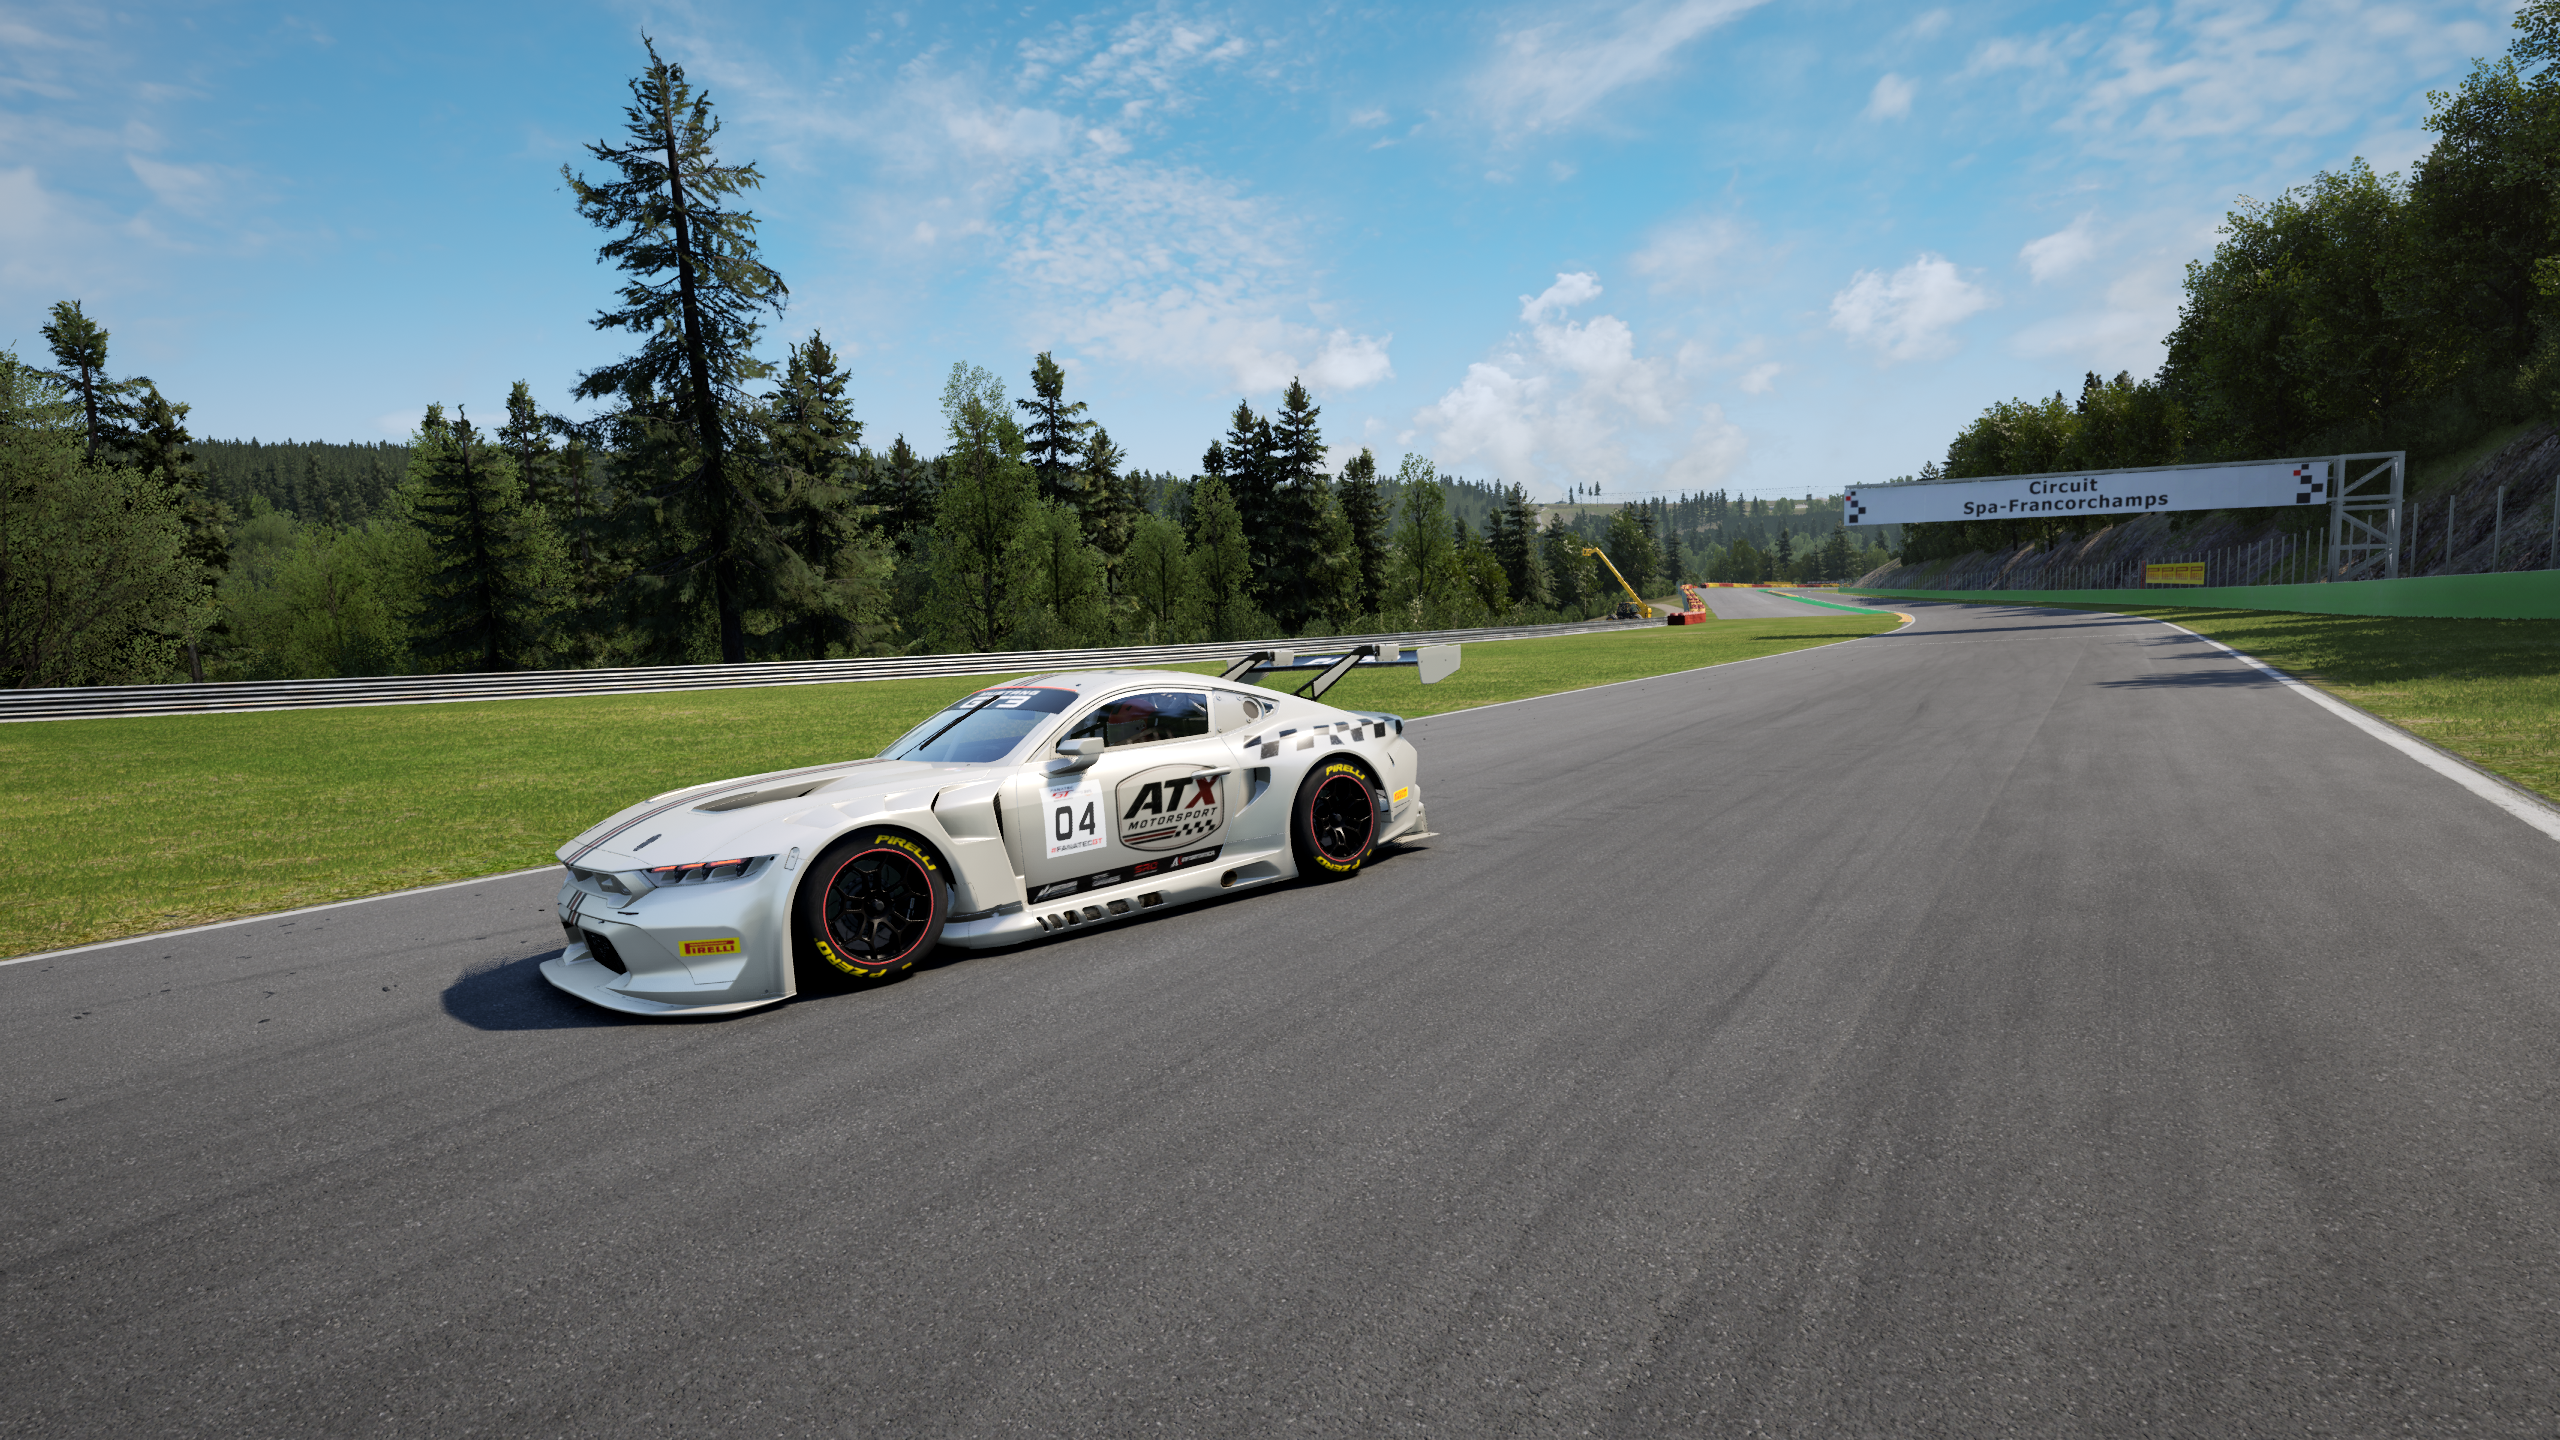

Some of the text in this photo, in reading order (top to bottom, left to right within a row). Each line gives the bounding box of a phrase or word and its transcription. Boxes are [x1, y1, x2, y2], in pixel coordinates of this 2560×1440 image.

[2029, 478, 2098, 495] Circuit
[1963, 494, 2169, 517] Spa-Francorchamps
[1326, 763, 1365, 780] PIRELLI
[1123, 775, 1219, 820] ATX
[1055, 801, 1095, 841] 04
[1128, 807, 1218, 831] MOTORSPORT
[874, 834, 937, 871] PIRELLI
[1051, 838, 1103, 853] #FANATECGT
[684, 940, 735, 955] PIRELLI
